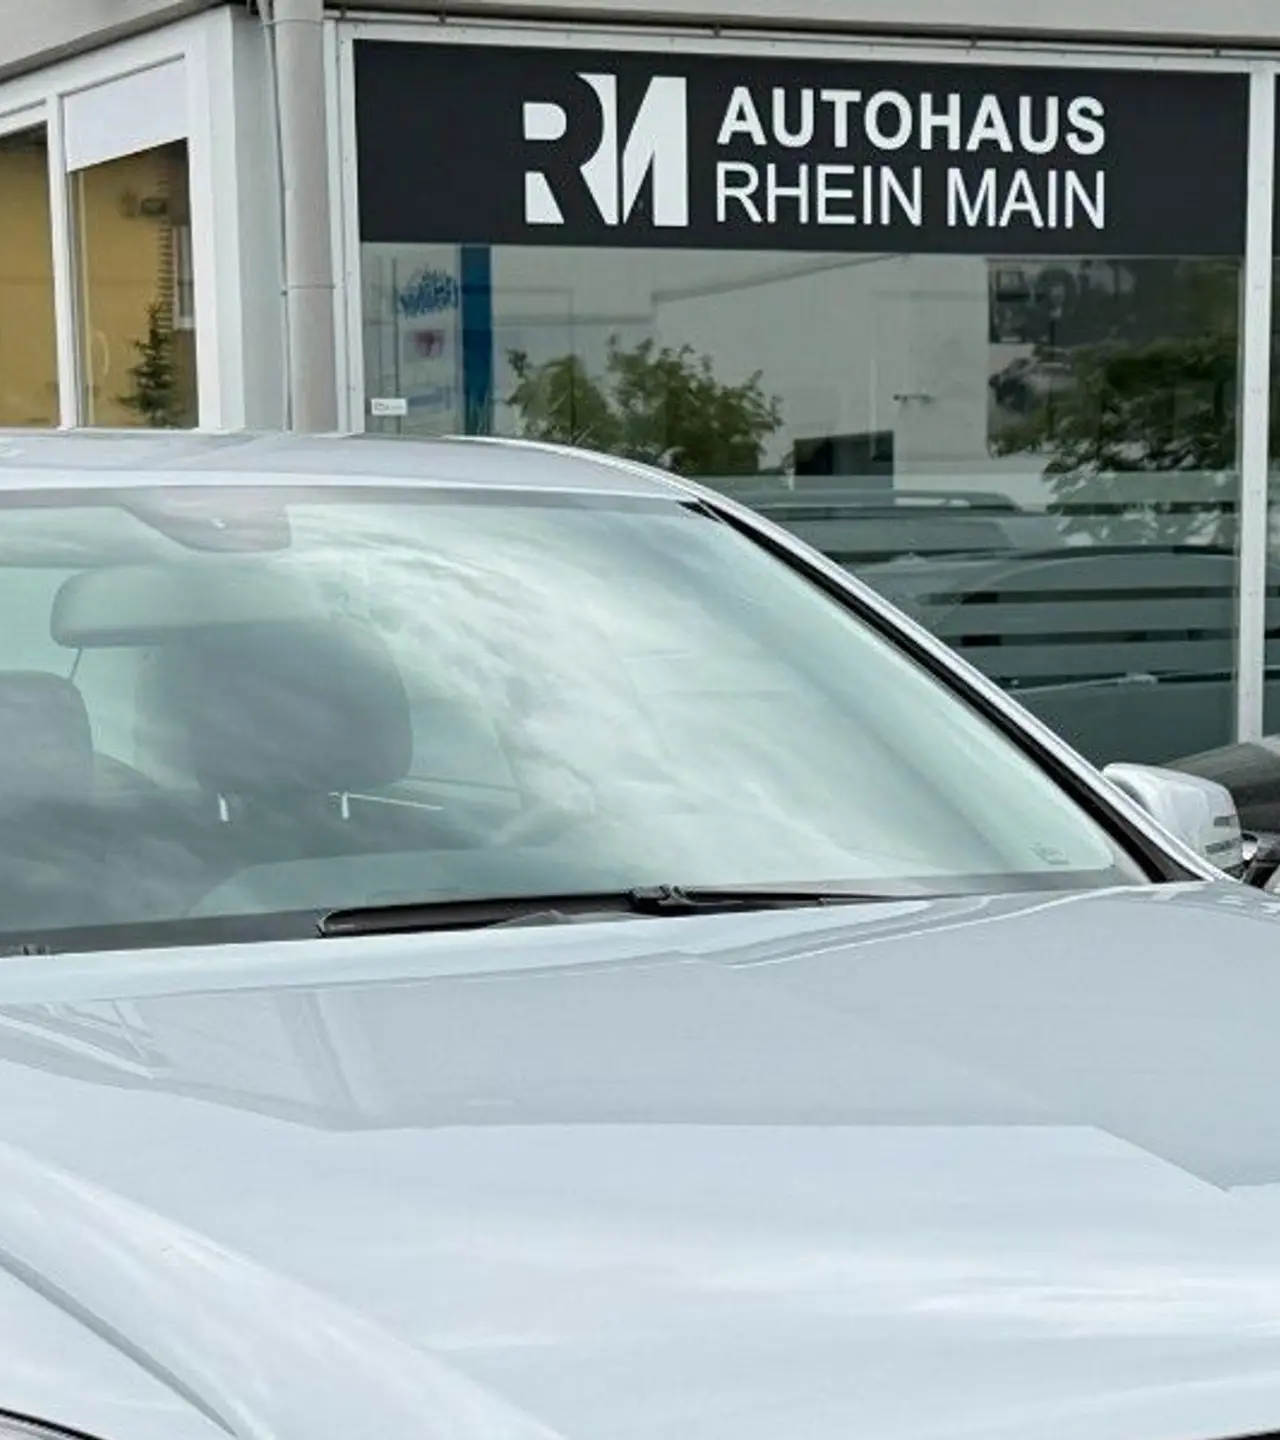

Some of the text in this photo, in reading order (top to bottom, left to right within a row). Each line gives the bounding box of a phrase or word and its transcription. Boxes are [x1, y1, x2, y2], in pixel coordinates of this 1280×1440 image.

[716, 86, 1106, 155] AUTOHAUS
[716, 161, 1105, 229] RHEIN MAIN
